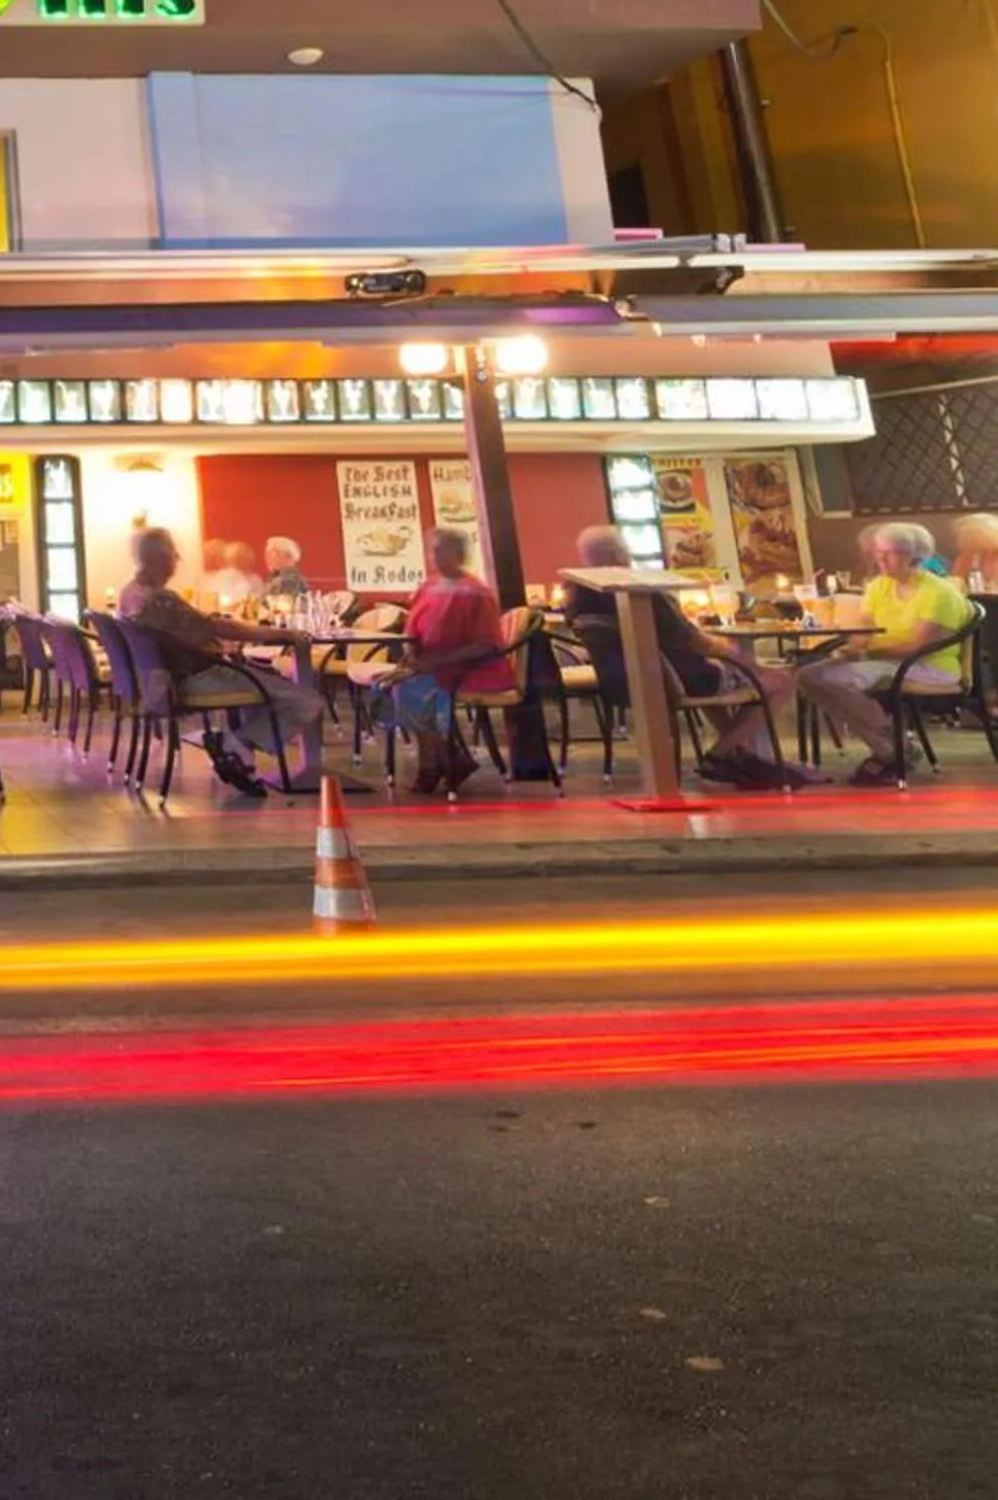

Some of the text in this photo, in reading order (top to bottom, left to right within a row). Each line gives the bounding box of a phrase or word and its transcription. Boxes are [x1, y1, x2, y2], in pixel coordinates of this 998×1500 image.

[345, 465, 410, 482] The Best
[344, 484, 412, 498] ENGLISH
[344, 501, 417, 521] Breakfast
